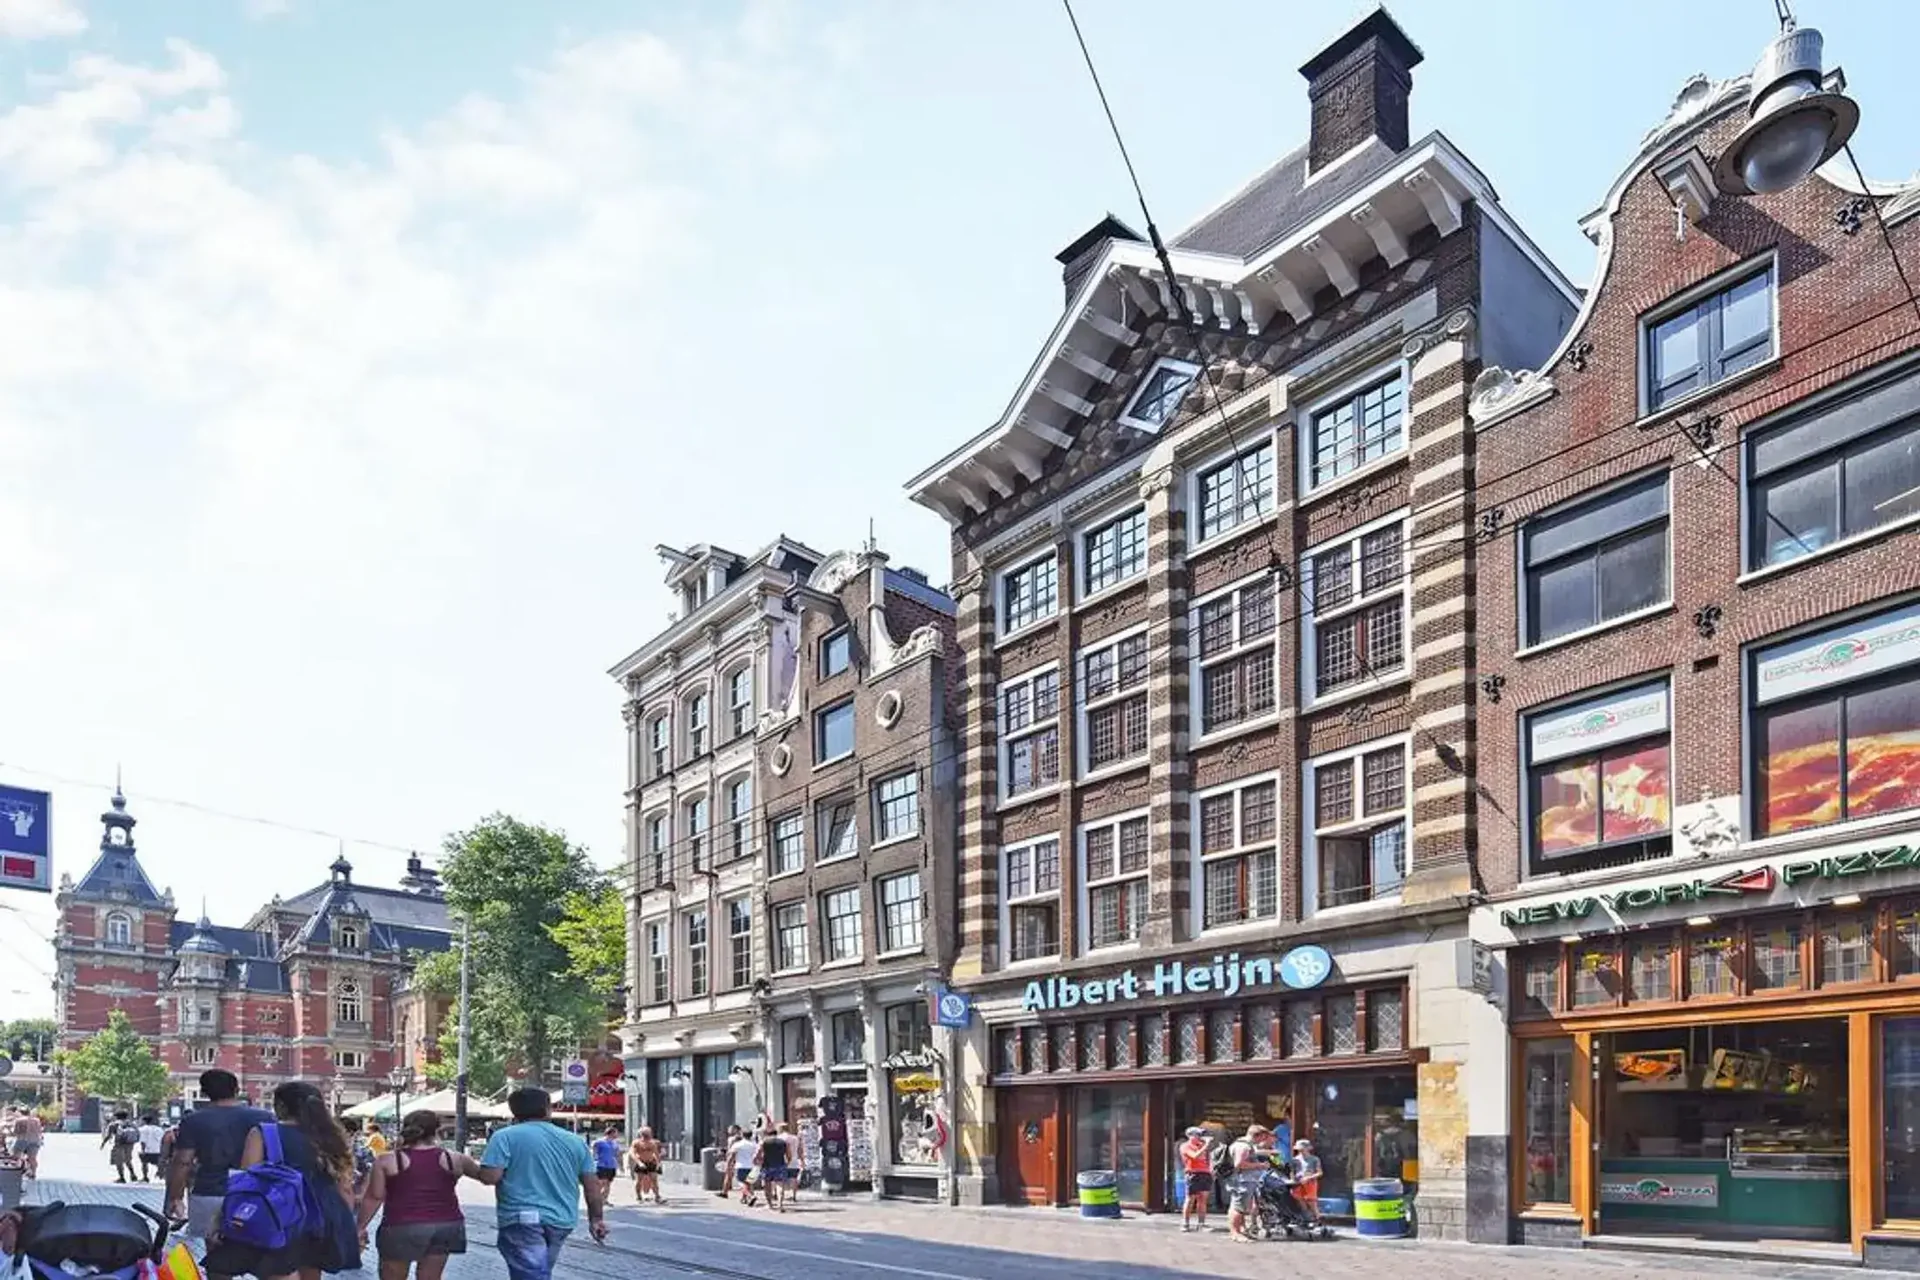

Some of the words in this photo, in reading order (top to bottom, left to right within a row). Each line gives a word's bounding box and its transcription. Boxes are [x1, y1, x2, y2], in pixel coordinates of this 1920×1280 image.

[1500, 896, 1600, 926] NEW
[1600, 869, 1744, 914] YORK
[1021, 969, 1138, 1012] Albert
[1153, 952, 1273, 997] Heijn
